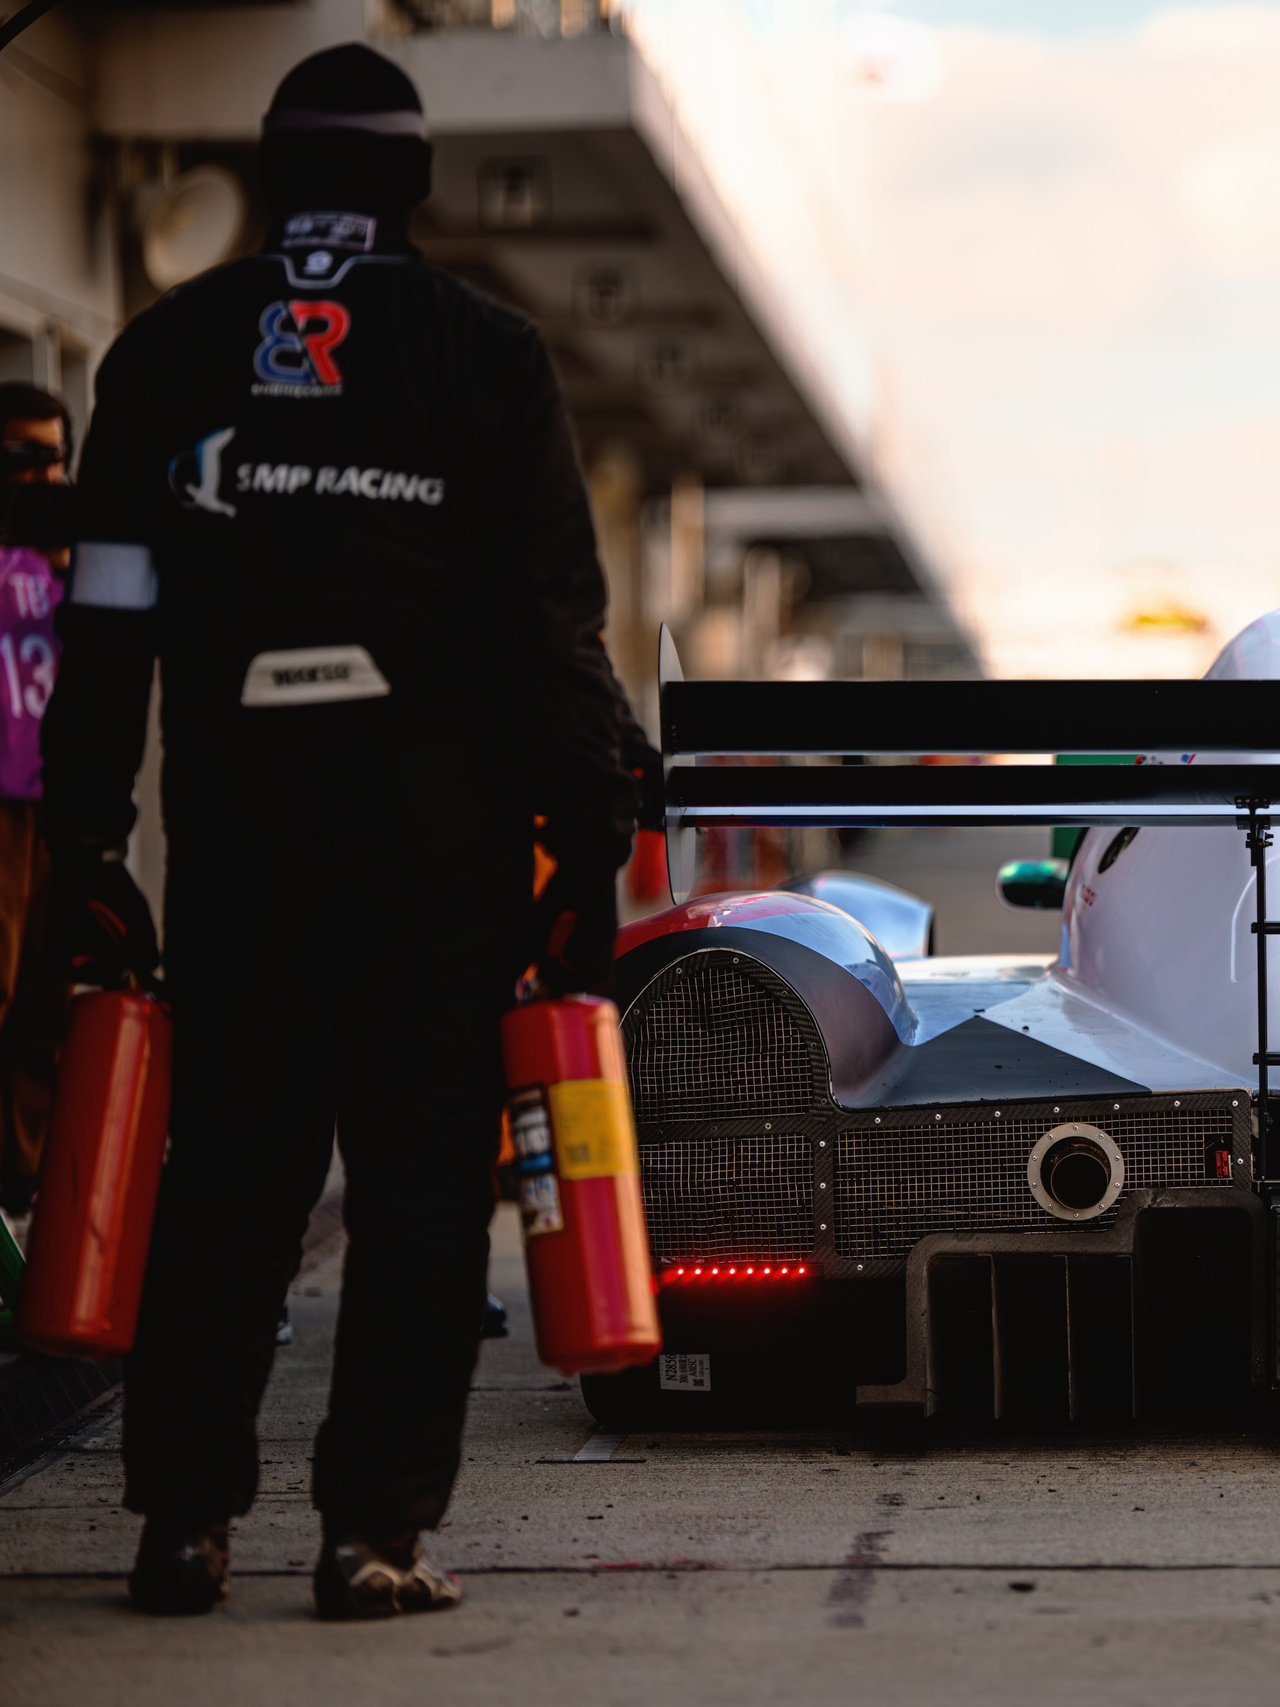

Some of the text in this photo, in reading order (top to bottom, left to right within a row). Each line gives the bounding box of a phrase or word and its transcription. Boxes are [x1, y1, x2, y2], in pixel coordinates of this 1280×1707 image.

[237, 463, 444, 506] SMP RACING
[0, 633, 54, 719] 13
